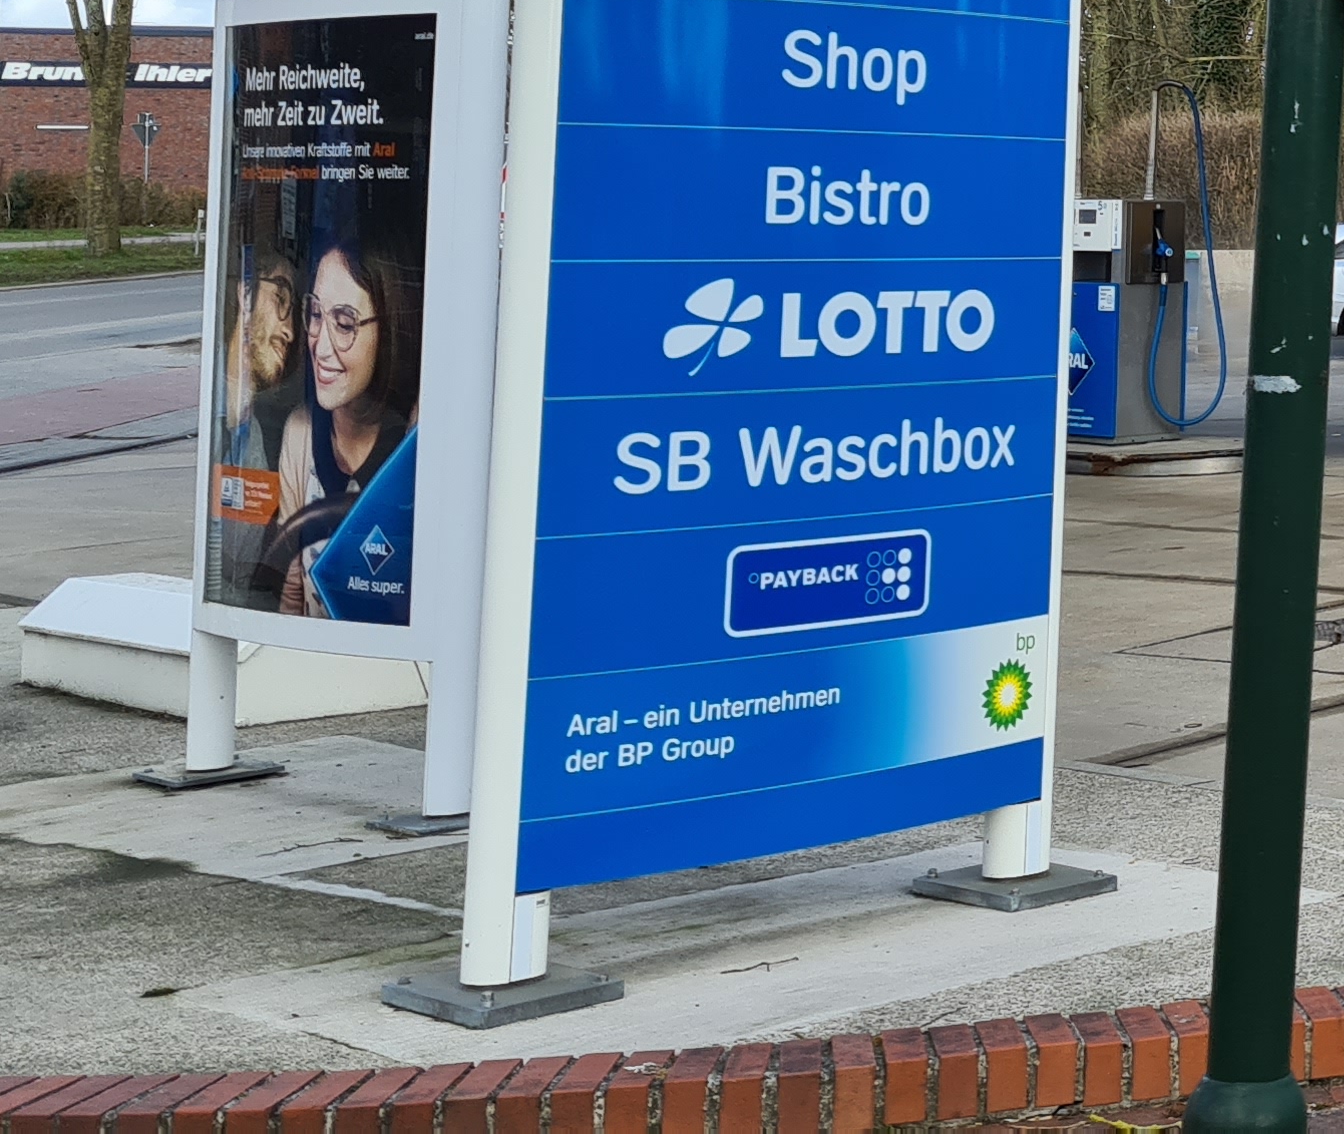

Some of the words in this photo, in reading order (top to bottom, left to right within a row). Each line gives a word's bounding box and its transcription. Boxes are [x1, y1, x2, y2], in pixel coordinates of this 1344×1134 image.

[1, 61, 86, 81] Brun
[134, 63, 213, 83] Ihler
[245, 66, 276, 91] Mehr
[279, 61, 365, 92] Reichweite,
[782, 29, 927, 105] Shop
[243, 100, 274, 127] mehr
[276, 100, 303, 126] Zeit
[307, 106, 325, 126] zu
[330, 98, 384, 126] Zweit.
[307, 141, 352, 158] Kraftstoffe
[354, 141, 371, 157] mit
[372, 141, 396, 157] Aral
[321, 164, 355, 182] bringen
[358, 164, 374, 179] Sie
[376, 164, 410, 179] weiter.
[765, 165, 931, 226] Bistro
[780, 289, 995, 358] LOTTO
[1068, 352, 1089, 369] RAL
[613, 429, 711, 495] SB
[738, 416, 1016, 488] Waschbox
[364, 542, 388, 556] ARAL
[347, 576, 369, 591] Alles
[370, 580, 405, 596] super.
[760, 564, 859, 590] PAYBACK
[1016, 632, 1035, 655] bp
[566, 710, 618, 738] Aral
[643, 704, 680, 729] ein
[689, 687, 840, 723] Unternehmen
[565, 750, 609, 773] der
[617, 742, 653, 767] BP
[661, 735, 735, 761] Group
